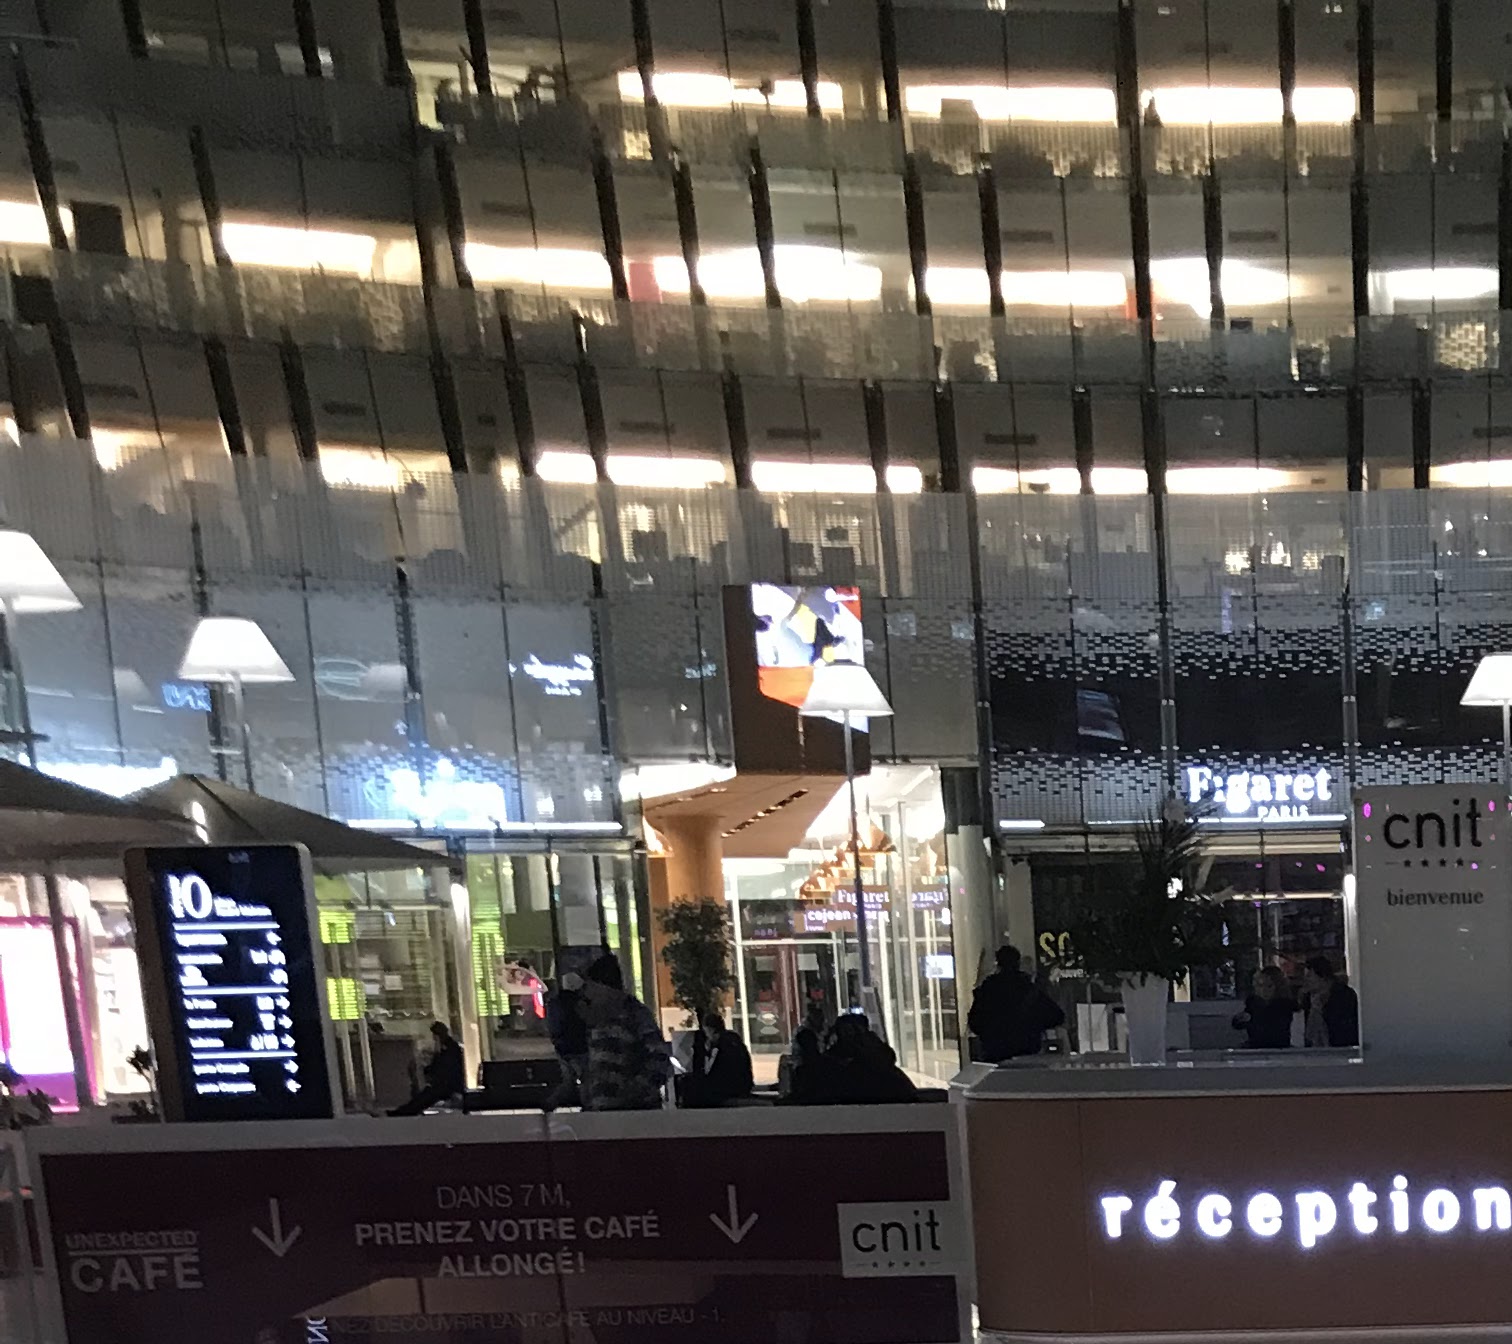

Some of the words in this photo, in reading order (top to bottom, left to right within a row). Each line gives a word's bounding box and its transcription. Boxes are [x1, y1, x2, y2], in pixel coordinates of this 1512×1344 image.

[1257, 805, 1310, 818] PARIS
[1383, 798, 1481, 849] cnit
[1386, 887, 1485, 908] bienvenue
[437, 1185, 512, 1210] DANS
[1100, 1177, 1512, 1248] réception
[355, 1216, 473, 1247] PRENEZ
[481, 1219, 577, 1244] VOTRE
[586, 1213, 661, 1240] CAFÉ
[850, 1209, 941, 1253] cnit
[69, 1250, 204, 1293] CAFÉ
[596, 1311, 623, 1326] AU
[627, 1308, 695, 1326] NIVEAU
